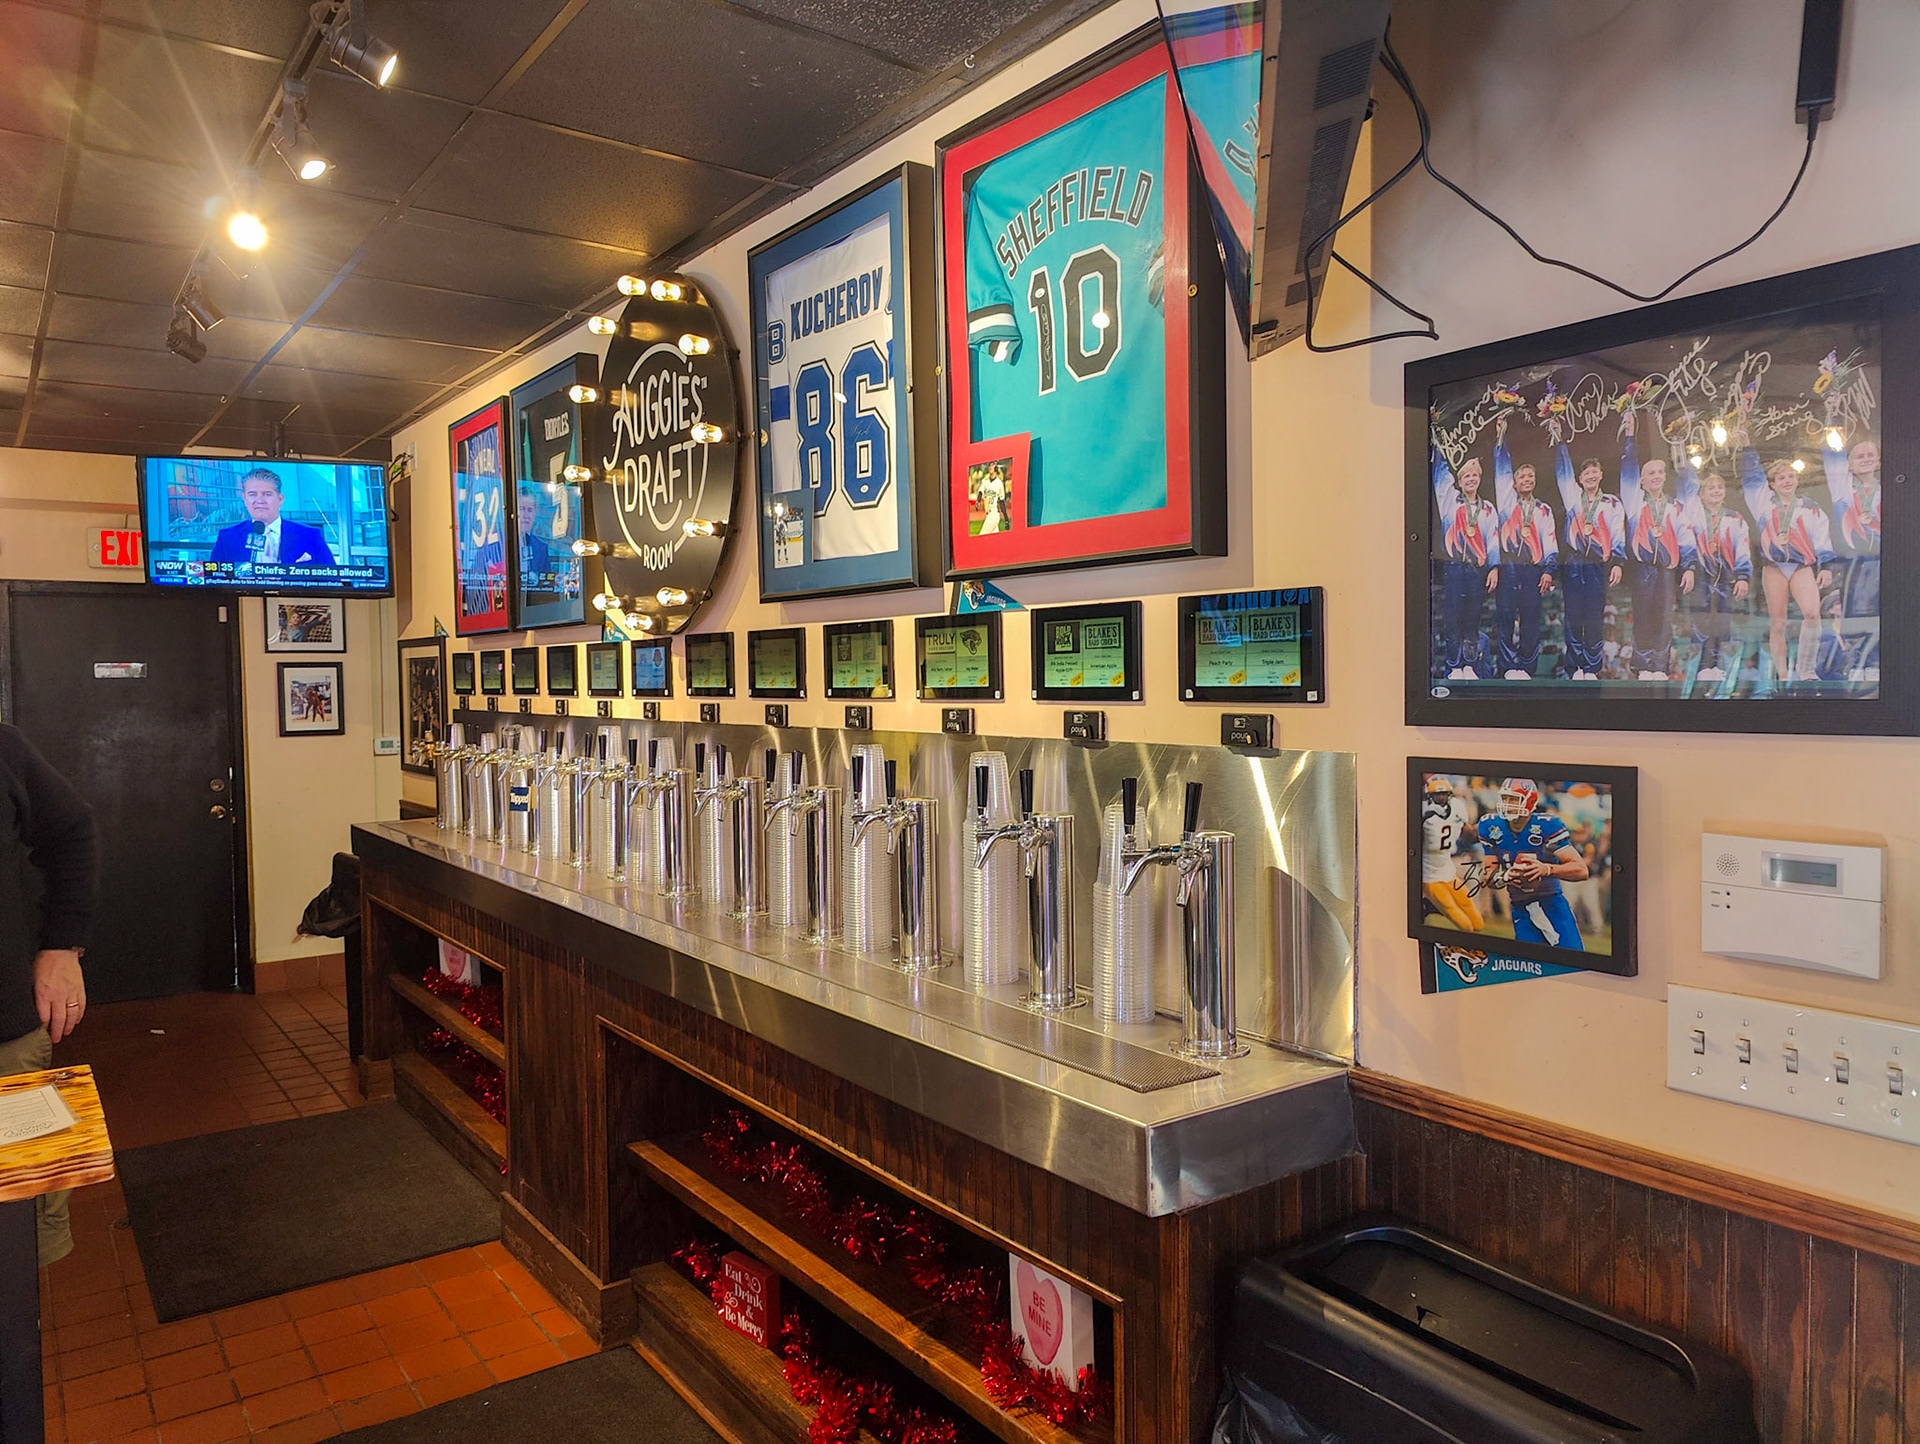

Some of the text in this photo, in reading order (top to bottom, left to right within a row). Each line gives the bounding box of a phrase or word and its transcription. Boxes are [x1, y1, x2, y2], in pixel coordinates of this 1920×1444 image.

[996, 166, 1154, 280] SHEFFIELD
[790, 265, 883, 342] KUCHEROV
[1027, 243, 1122, 397] 10
[603, 362, 703, 471] AUGGIE'S
[794, 340, 891, 518] 86
[624, 440, 697, 531] DRAFT
[472, 487, 500, 548] 32
[101, 530, 142, 566] EXI
[643, 539, 673, 572] ROOM
[204, 563, 233, 571] 38 35
[254, 566, 372, 577] Chiefs: Zero sacks allowed
[1088, 625, 1117, 639] BLAKE'S
[1202, 619, 1238, 633] BLAKE'S
[1253, 616, 1291, 631] BLAKE'S
[926, 633, 955, 646] TRULY
[1440, 825, 1451, 850] 2
[1491, 958, 1542, 976] JAGUARS
[725, 1263, 742, 1285] Eat
[734, 1282, 764, 1311] Drink
[1033, 1290, 1046, 1313] BE
[725, 1305, 765, 1343] Be Merry
[745, 1305, 755, 1321] &
[1028, 1305, 1052, 1337] MINE
